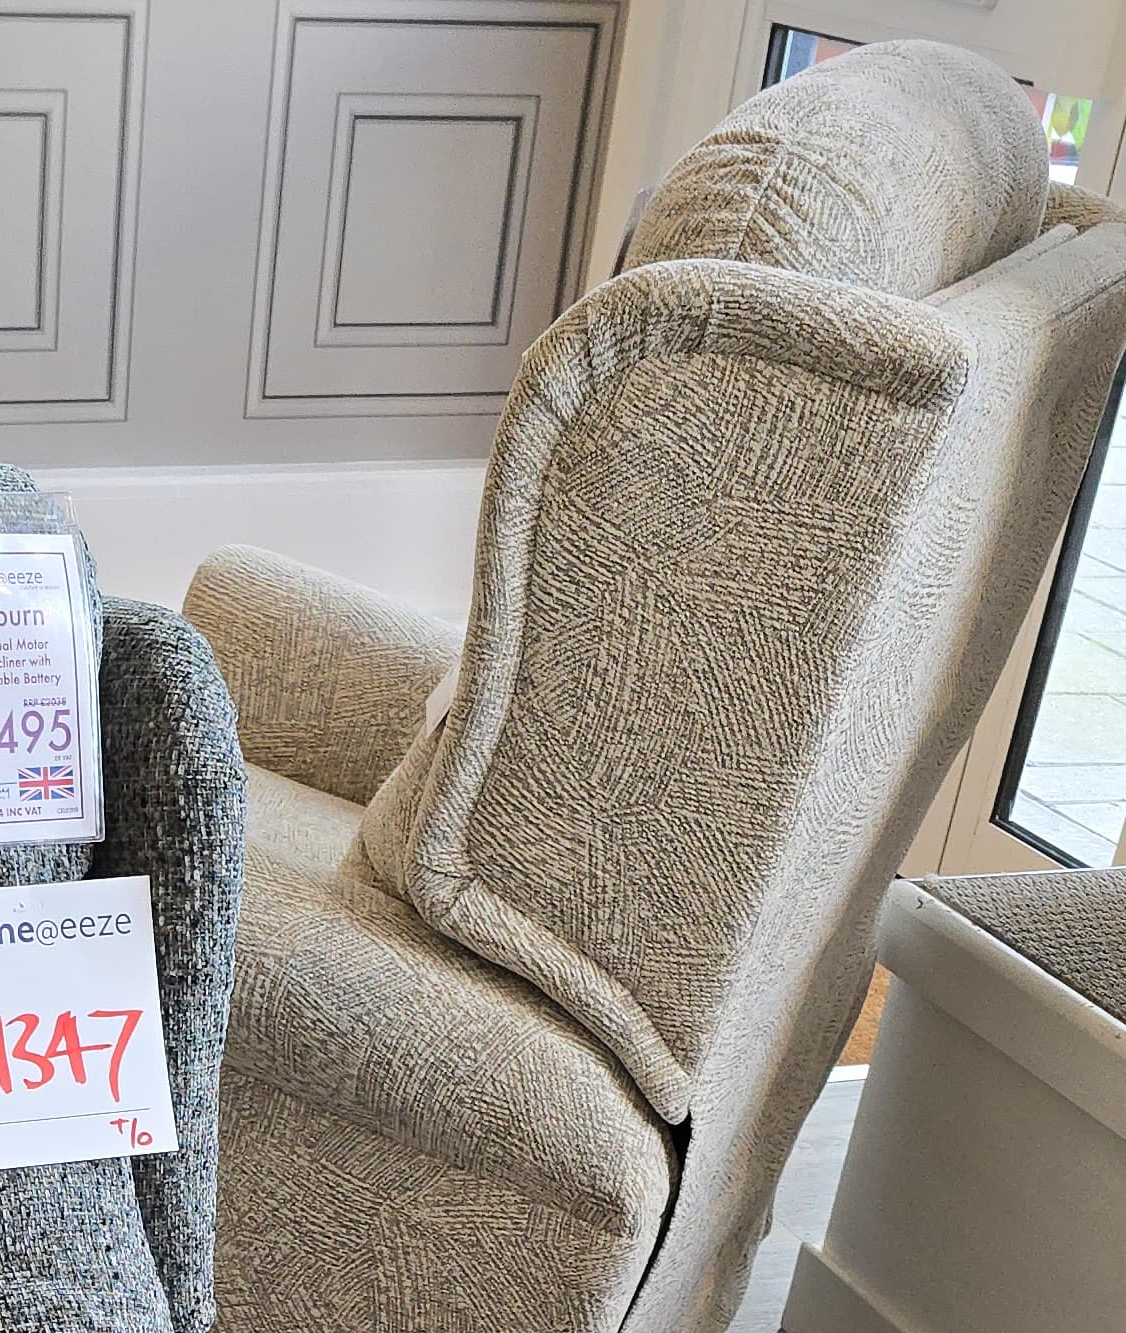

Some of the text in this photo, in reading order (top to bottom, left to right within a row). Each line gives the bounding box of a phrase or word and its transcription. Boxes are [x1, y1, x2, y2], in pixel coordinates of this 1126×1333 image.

[16, 638, 49, 650] Motor
[29, 654, 51, 666] with
[24, 672, 61, 686] Battery
[6, 808, 23, 817] INC
[24, 806, 42, 816] VAT
